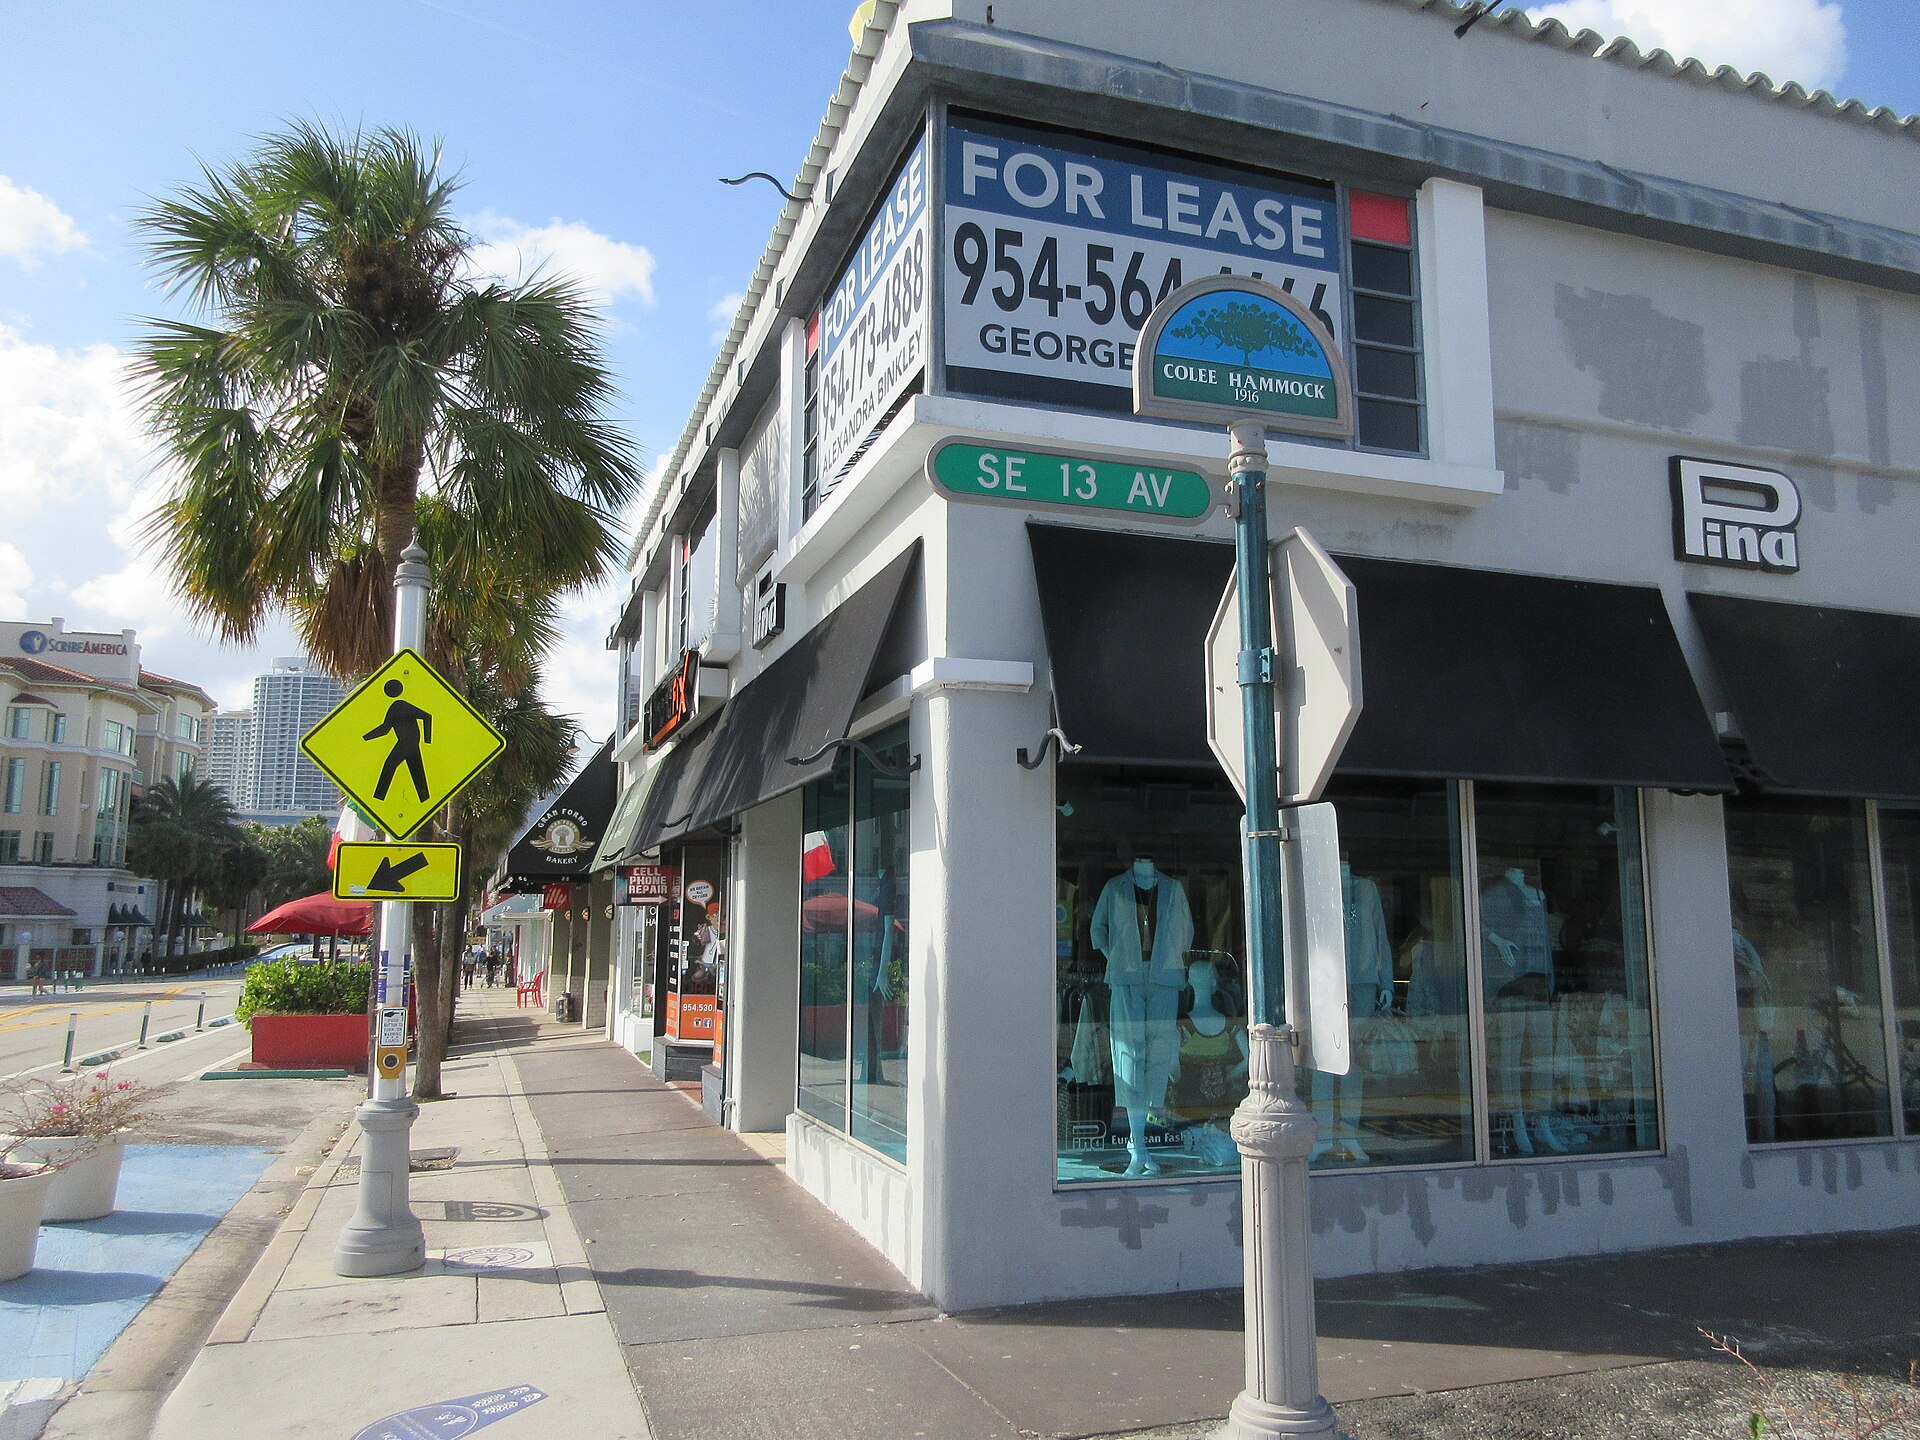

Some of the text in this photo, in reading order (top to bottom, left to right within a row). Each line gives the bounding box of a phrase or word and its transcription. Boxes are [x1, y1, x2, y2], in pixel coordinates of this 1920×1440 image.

[962, 140, 1325, 259] FOR LEASE
[823, 150, 923, 356] FOR LEASE
[979, 323, 1134, 371] GEORGE
[1163, 363, 1326, 400] COLEE HAMMOCK
[822, 322, 923, 478] ALEXANDRA BINKLEY
[1234, 388, 1260, 404] 1916
[977, 453, 1173, 508] SE 13 AV
[1675, 457, 1800, 569] Pina
[537, 808, 588, 828] GRAN FORNO
[545, 855, 578, 865] BAKERY
[629, 876, 667, 885] PHONE
[633, 867, 661, 876] CELL
[545, 887, 568, 908] illy
[628, 884, 668, 894] REPAIR
[1111, 1134, 1161, 1145] Euroean
